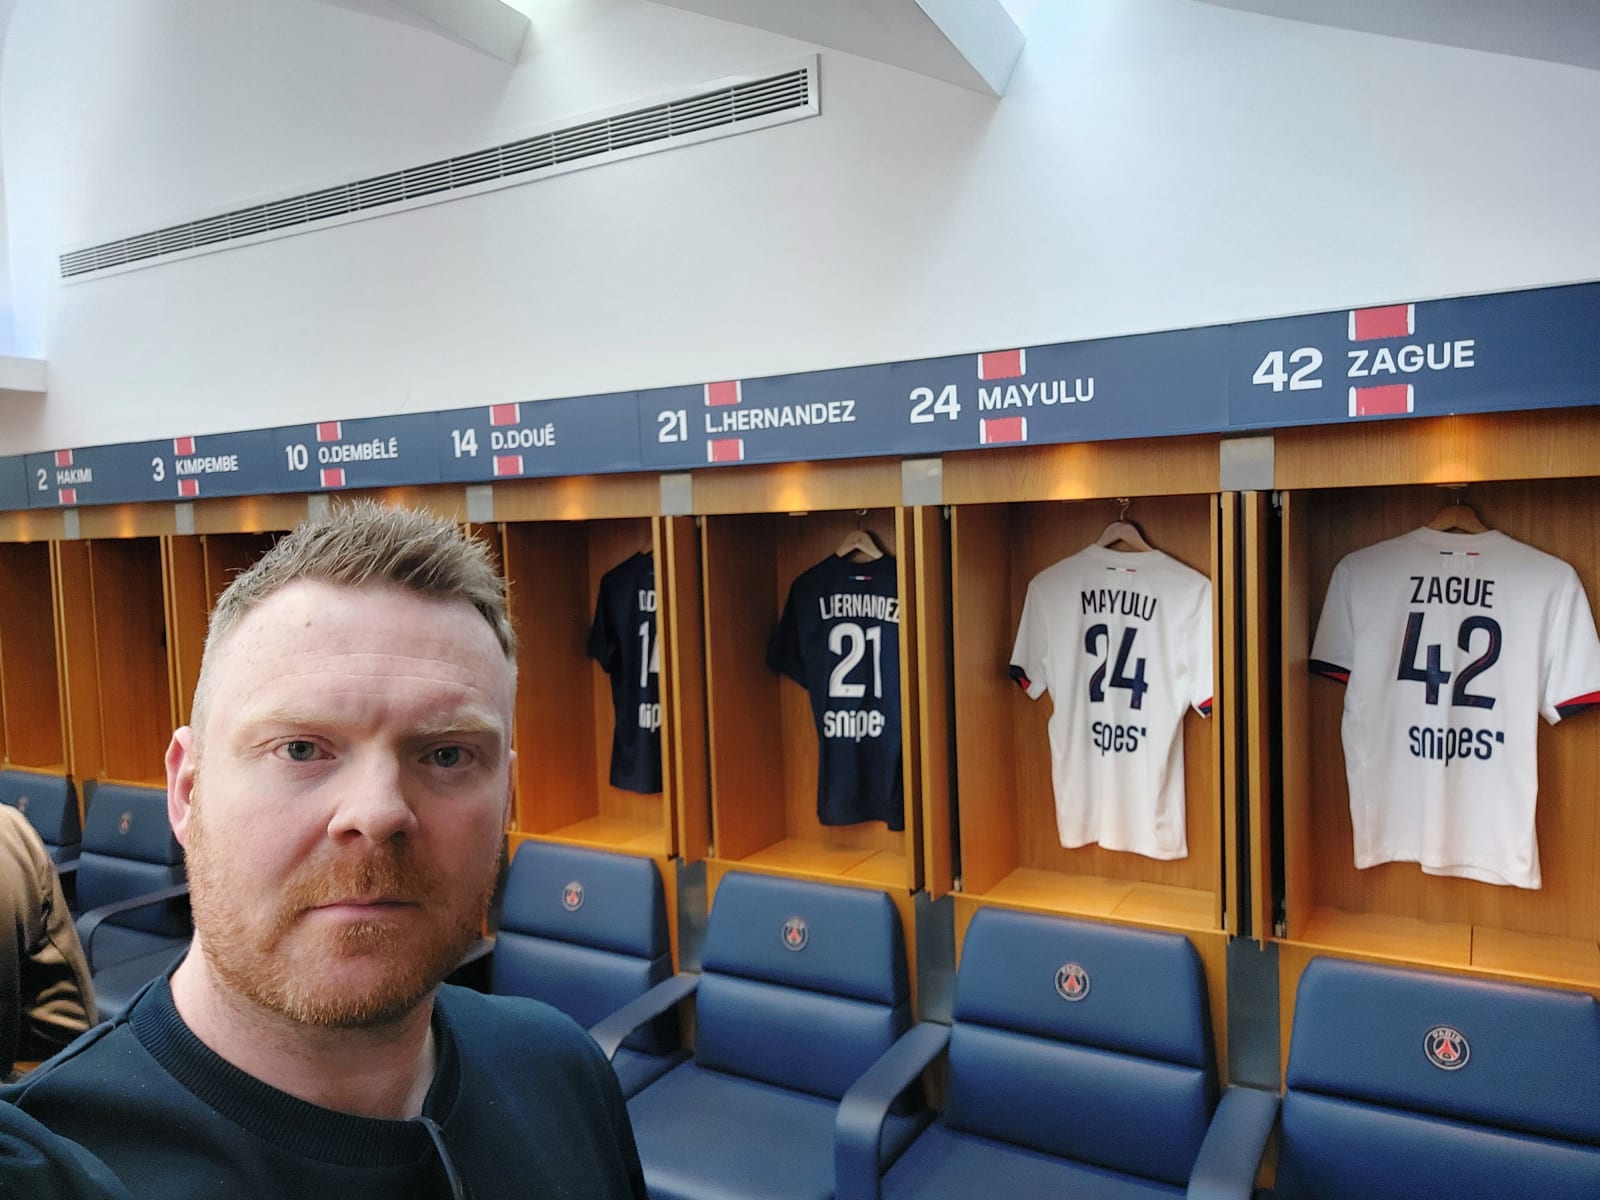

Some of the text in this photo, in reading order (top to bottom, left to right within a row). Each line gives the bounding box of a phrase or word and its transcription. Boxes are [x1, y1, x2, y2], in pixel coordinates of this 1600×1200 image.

[1252, 339, 1475, 393] 42 ZAGUE
[658, 400, 856, 442] 21 L.HERNANDEZ
[909, 378, 1095, 423] 24 MAYULU
[285, 437, 398, 471] 10 O.DEMBÉLÉ
[451, 423, 555, 458] 14 D.DOUÉ
[37, 468, 92, 491] 2 HAKIMI
[152, 455, 239, 482] 3 KIMPEMBE
[1081, 589, 1157, 621] MAYULU
[1410, 576, 1495, 608] ZAGUE
[828, 622, 882, 699] 21
[1085, 623, 1148, 710] 24
[1397, 612, 1502, 710] 42
[1408, 725, 1494, 767] snipes
